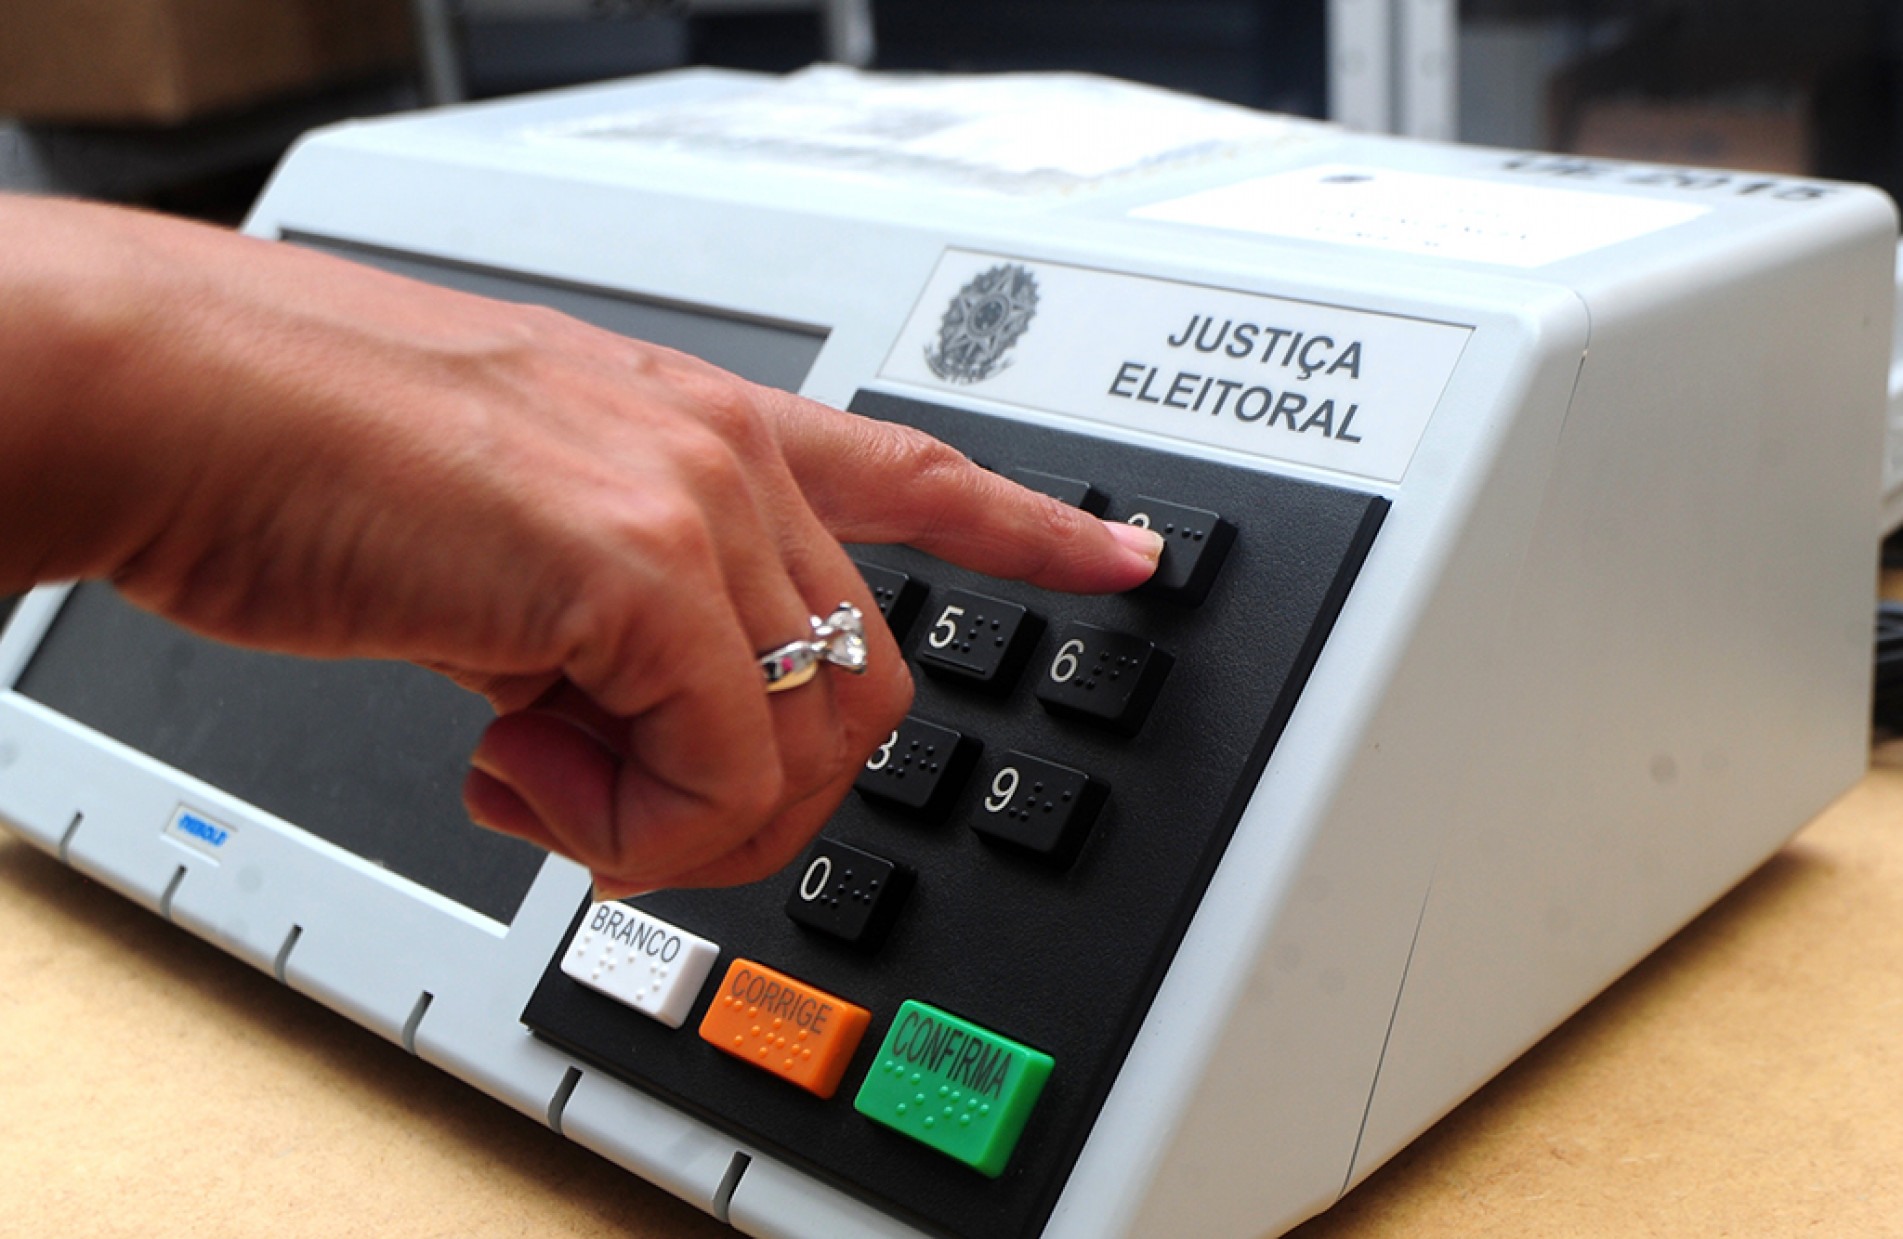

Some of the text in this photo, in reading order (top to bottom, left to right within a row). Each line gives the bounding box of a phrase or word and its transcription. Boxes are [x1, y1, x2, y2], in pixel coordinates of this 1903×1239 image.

[1167, 314, 1362, 380] JUSTIÇA
[1108, 361, 1362, 443] ELEITORAL
[928, 605, 964, 649] 5
[1049, 638, 1085, 683] 6
[984, 767, 1019, 813] 9
[799, 856, 832, 901] 0
[590, 904, 682, 964] BRANCO
[731, 968, 833, 1036] CORRIGE
[892, 1010, 1013, 1097] CONFIRMA
